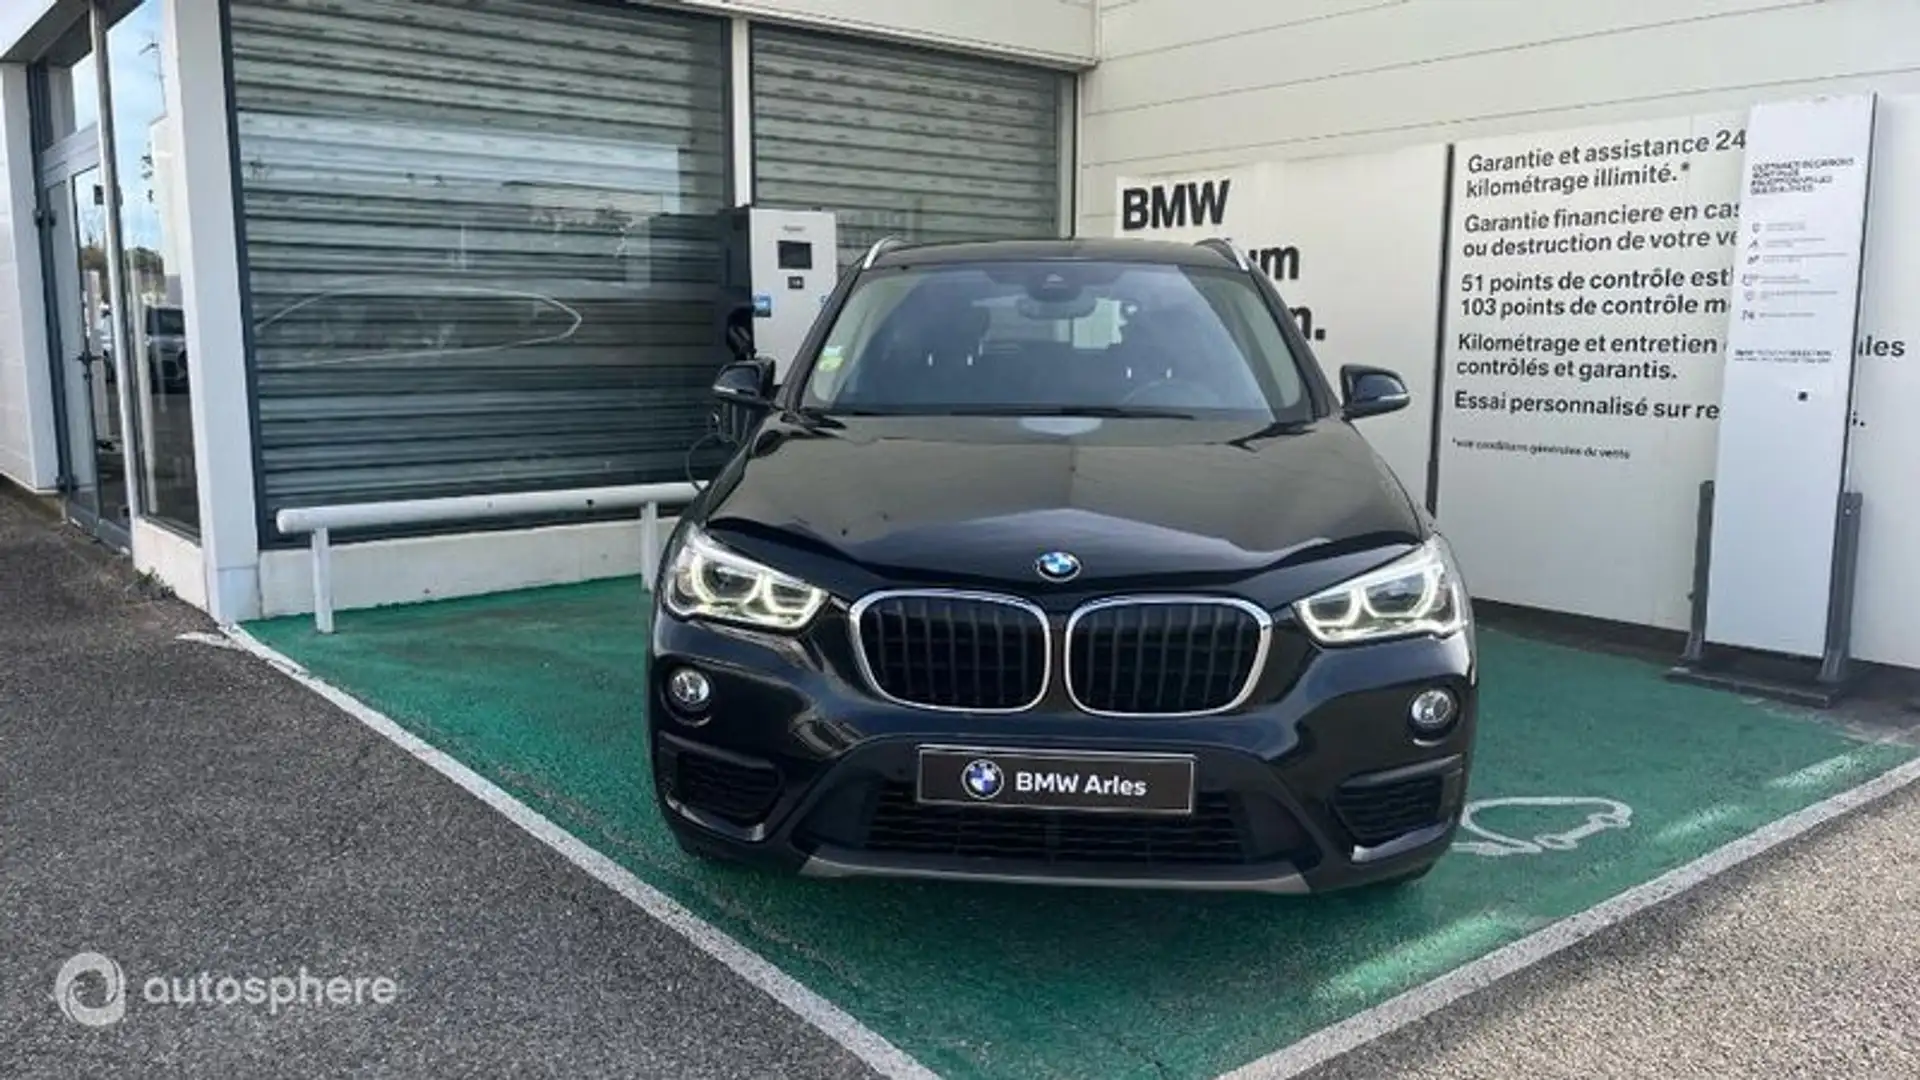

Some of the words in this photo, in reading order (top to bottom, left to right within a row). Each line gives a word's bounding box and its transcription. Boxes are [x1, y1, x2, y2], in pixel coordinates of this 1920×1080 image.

[1468, 148, 1554, 173] Garantie
[1559, 144, 1579, 165] et
[1584, 134, 1710, 162] assistance
[1466, 171, 1588, 198] kilométrage
[1123, 179, 1230, 230] BMW
[1464, 208, 1550, 233] Garantie
[1554, 203, 1664, 229] financiere
[1669, 203, 1698, 221] en
[1463, 240, 1487, 257] ou
[1492, 232, 1612, 257] destruction
[1617, 230, 1645, 251] de
[1651, 230, 1710, 249] votre
[1461, 274, 1483, 292] 51
[1490, 273, 1553, 295] points
[1558, 271, 1585, 290] de
[1590, 268, 1685, 289] contrôle
[1461, 298, 1497, 316] 103
[1501, 296, 1565, 320] points
[1570, 296, 1597, 315] de
[1602, 292, 1698, 315] contrôle
[1458, 333, 1580, 357] Kilométrage
[1586, 335, 1606, 353] et
[1611, 335, 1717, 354] entretien
[1456, 358, 1549, 378] contrôlés
[1554, 359, 1576, 378] et
[1579, 359, 1678, 382] garantis.
[1454, 391, 1506, 410] Essai
[1510, 394, 1648, 419] personnalisé
[1653, 401, 1692, 419] sur
[1695, 403, 1719, 420] re
[1016, 771, 1079, 793] BMW
[1084, 775, 1147, 796] Arles
